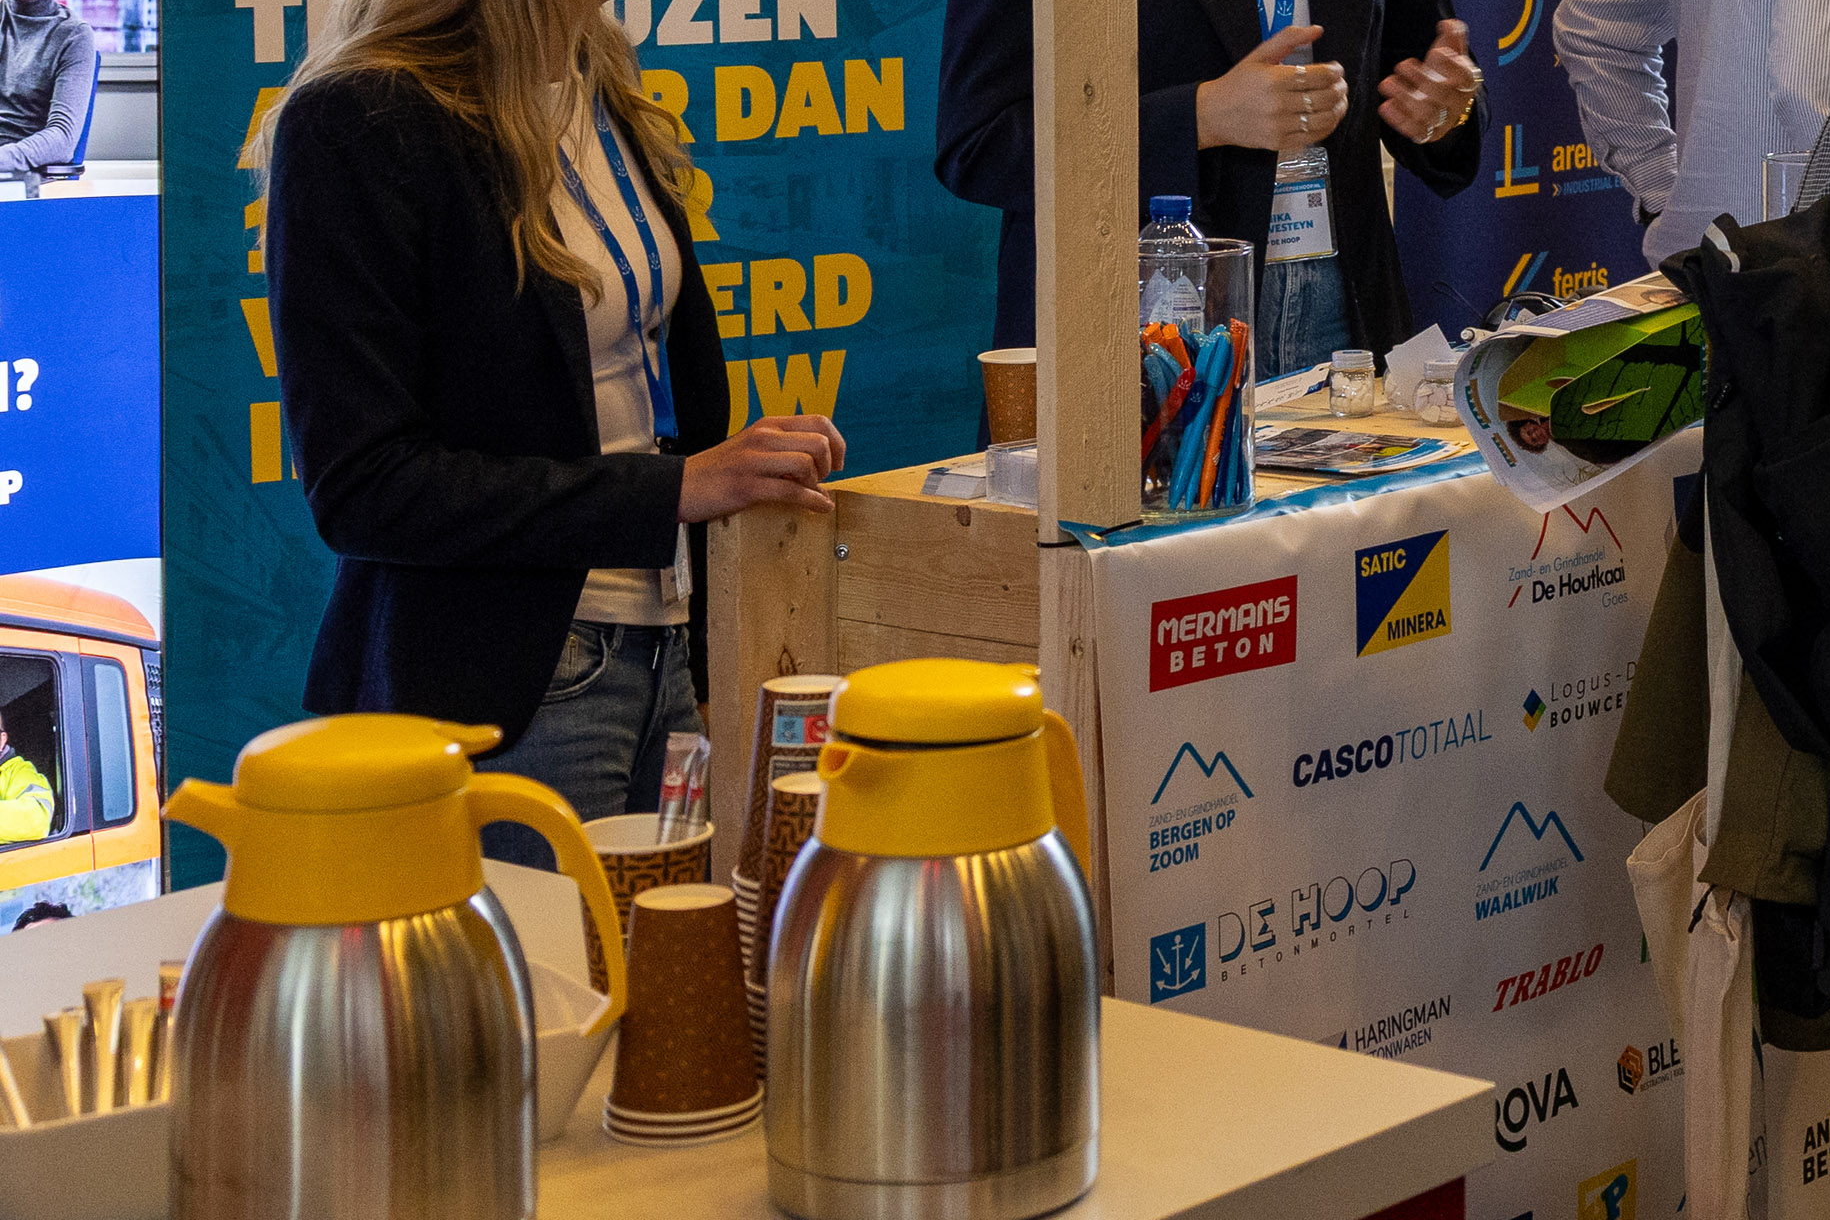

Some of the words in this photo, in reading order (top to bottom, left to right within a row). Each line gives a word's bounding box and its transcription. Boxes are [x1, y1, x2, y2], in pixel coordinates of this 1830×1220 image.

[714, 57, 905, 142] DAN
[1281, 236, 1301, 245] HOOP
[1553, 262, 1608, 298] ferris
[1360, 548, 1407, 578] SATIC
[1509, 563, 1536, 582] Zand-
[1540, 564, 1551, 575] en
[1553, 545, 1606, 571] Grindhandel
[1532, 580, 1555, 603] De
[1559, 559, 1626, 597] Houtkaai
[1602, 592, 1628, 608] Goes
[1157, 595, 1290, 646] MERMANS
[1387, 608, 1447, 642] MINERA
[1170, 632, 1274, 673] BETON
[1176, 809, 1187, 820] EN
[1187, 793, 1240, 817] GRINDHANDEL
[1150, 816, 1212, 850] BERGEN
[1215, 809, 1236, 830] OP
[1150, 842, 1199, 873] ZOOM
[1514, 857, 1569, 884] GRINDHANDEL
[1218, 899, 1276, 963] DE
[1291, 859, 1416, 937] HOOP
[1475, 875, 1559, 921] WAALWIJK
[1491, 943, 1604, 1013] TRABLO
[1355, 994, 1451, 1052] HARINGMAN
[1367, 1027, 1432, 1058] TONWAREN
